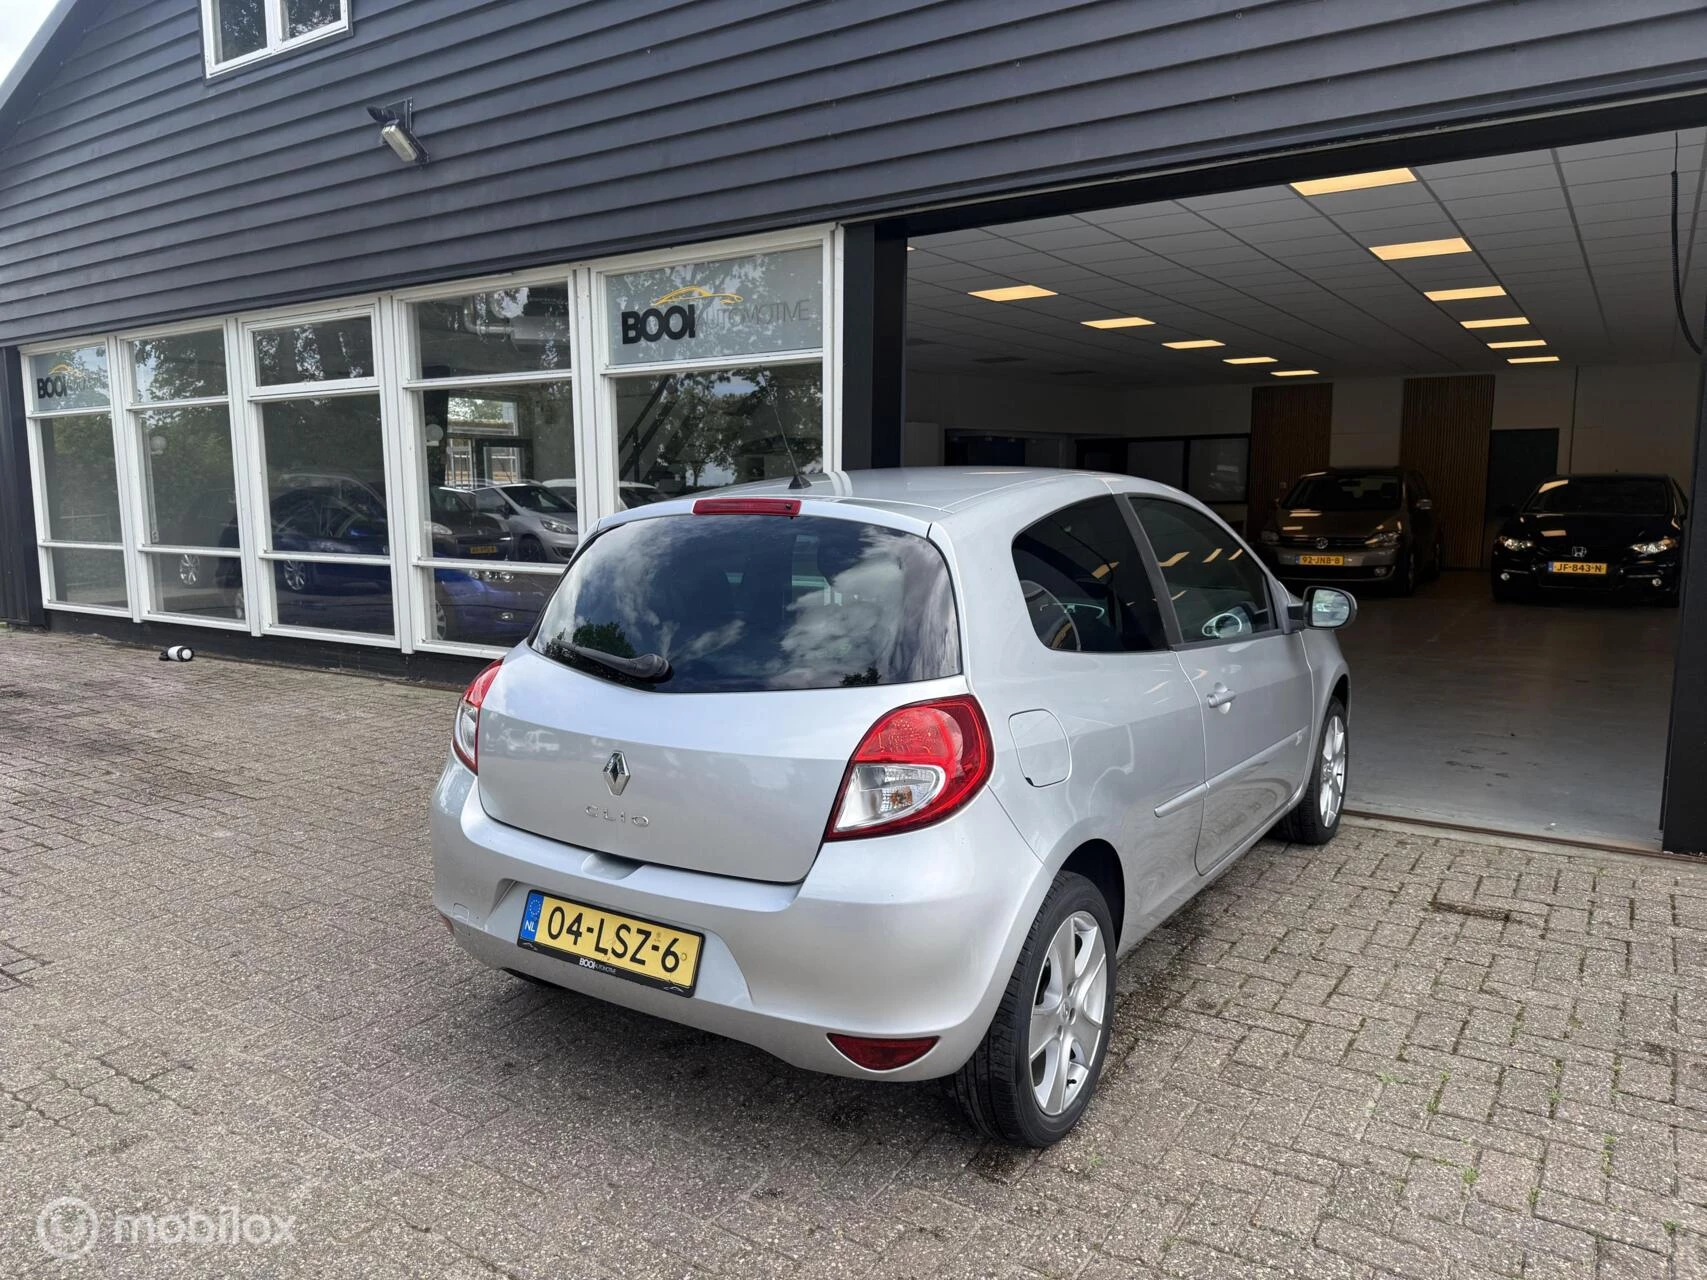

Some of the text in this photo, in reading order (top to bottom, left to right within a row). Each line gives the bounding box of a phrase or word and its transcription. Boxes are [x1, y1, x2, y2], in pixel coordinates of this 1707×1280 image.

[621, 298, 810, 344] BOOI AUTOMOTIVE
[37, 376, 67, 399] BOOI
[1557, 563, 1602, 573] JF-843-N
[584, 804, 649, 827] CLIO
[524, 920, 536, 933] NL
[547, 906, 680, 973] 04-LSZ-6
